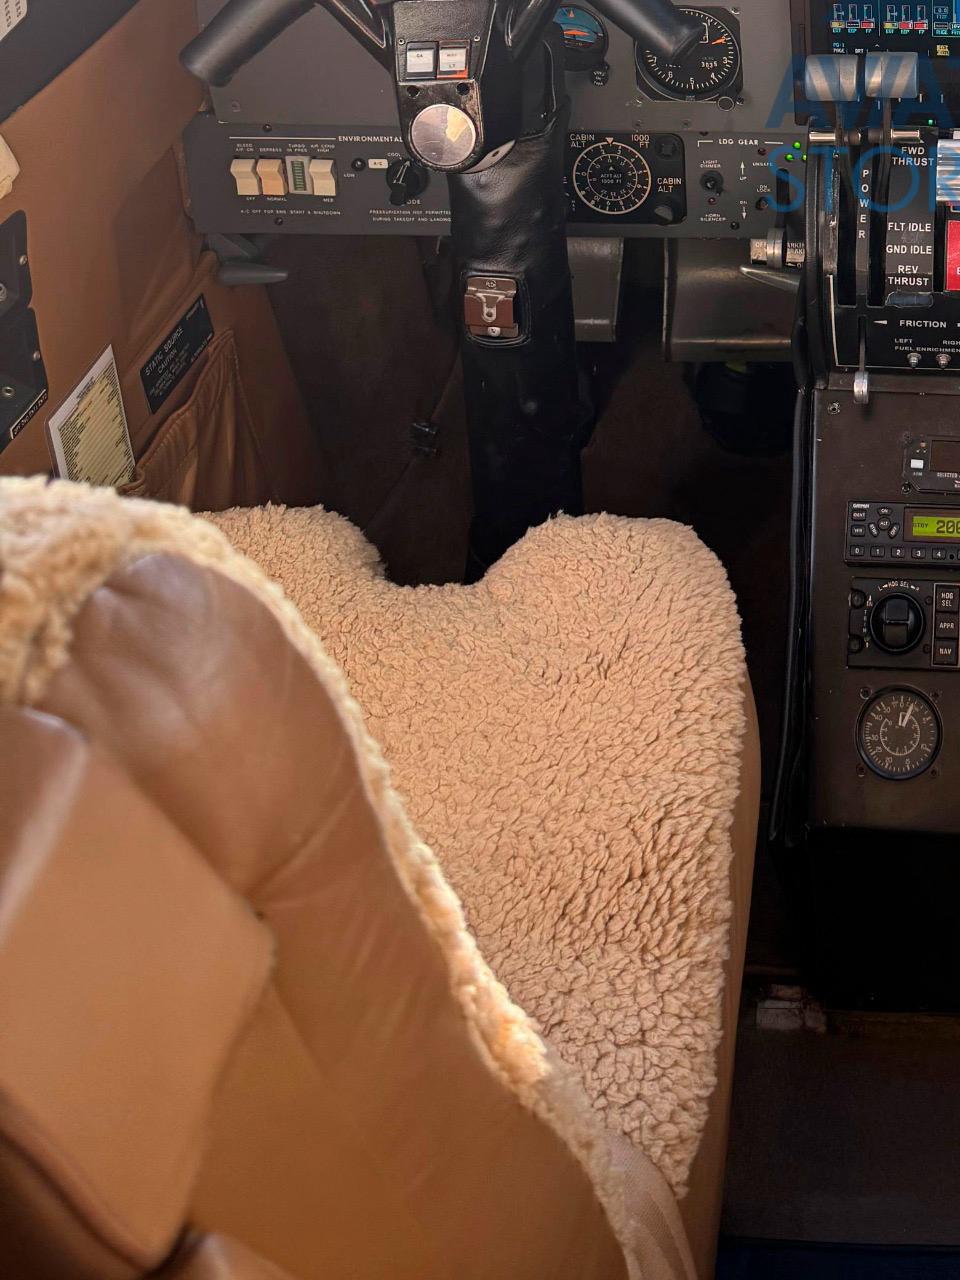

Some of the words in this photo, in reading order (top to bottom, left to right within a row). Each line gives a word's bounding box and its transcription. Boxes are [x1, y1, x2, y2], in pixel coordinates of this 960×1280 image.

[902, 146, 925, 155] FWD
[892, 157, 934, 166] THRUST
[888, 223, 906, 232] FLT
[908, 223, 931, 232] IDLE
[886, 246, 908, 254] GND
[910, 246, 932, 254] IDLE
[898, 266, 918, 274] REV
[888, 277, 929, 286] THRUST
[900, 320, 947, 328] FRICTION
